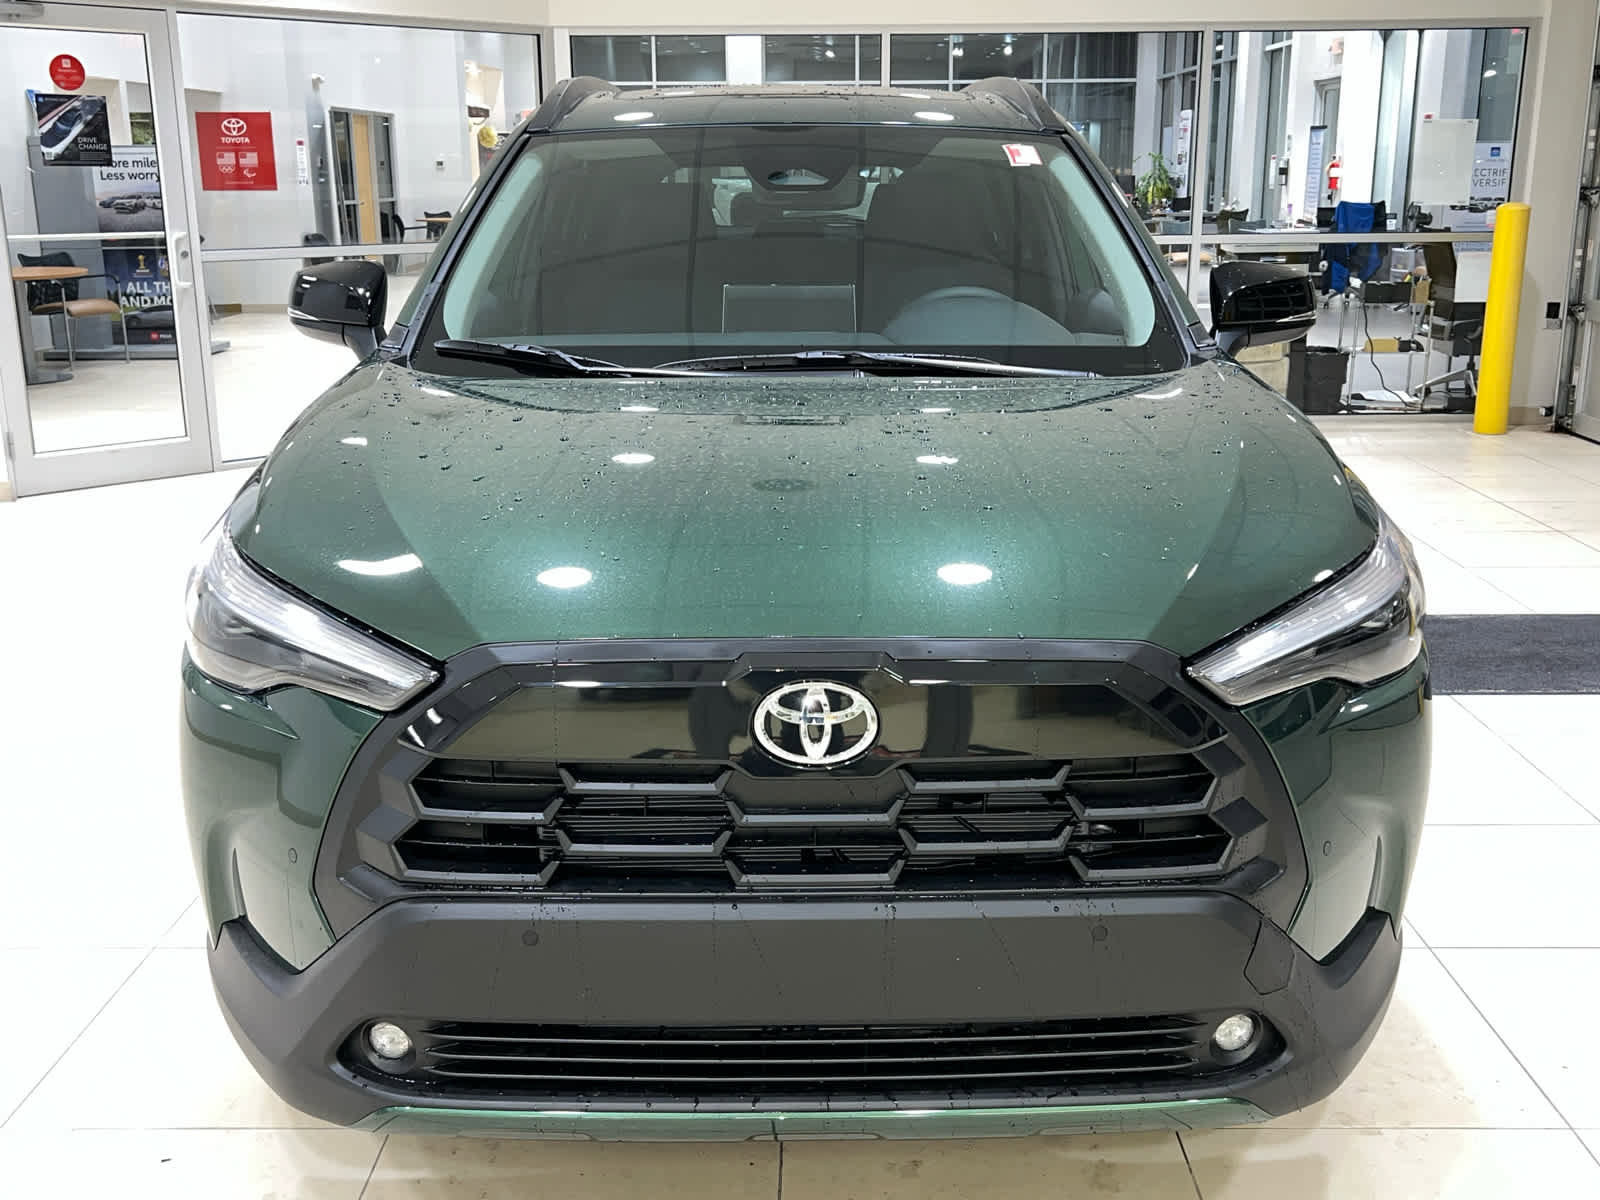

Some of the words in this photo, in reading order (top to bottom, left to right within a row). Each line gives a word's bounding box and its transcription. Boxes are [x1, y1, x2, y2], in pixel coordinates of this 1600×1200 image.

[220, 136, 250, 144] TOYOTA
[78, 143, 108, 151] CHANGE
[112, 159, 129, 168] ore
[132, 156, 157, 168] mile
[100, 170, 125, 181] Less
[1473, 168, 1508, 177] ECTRIF
[1472, 178, 1507, 187] VERSIF
[126, 281, 152, 293] ALL
[153, 281, 171, 293] TH
[120, 295, 151, 307] AND
